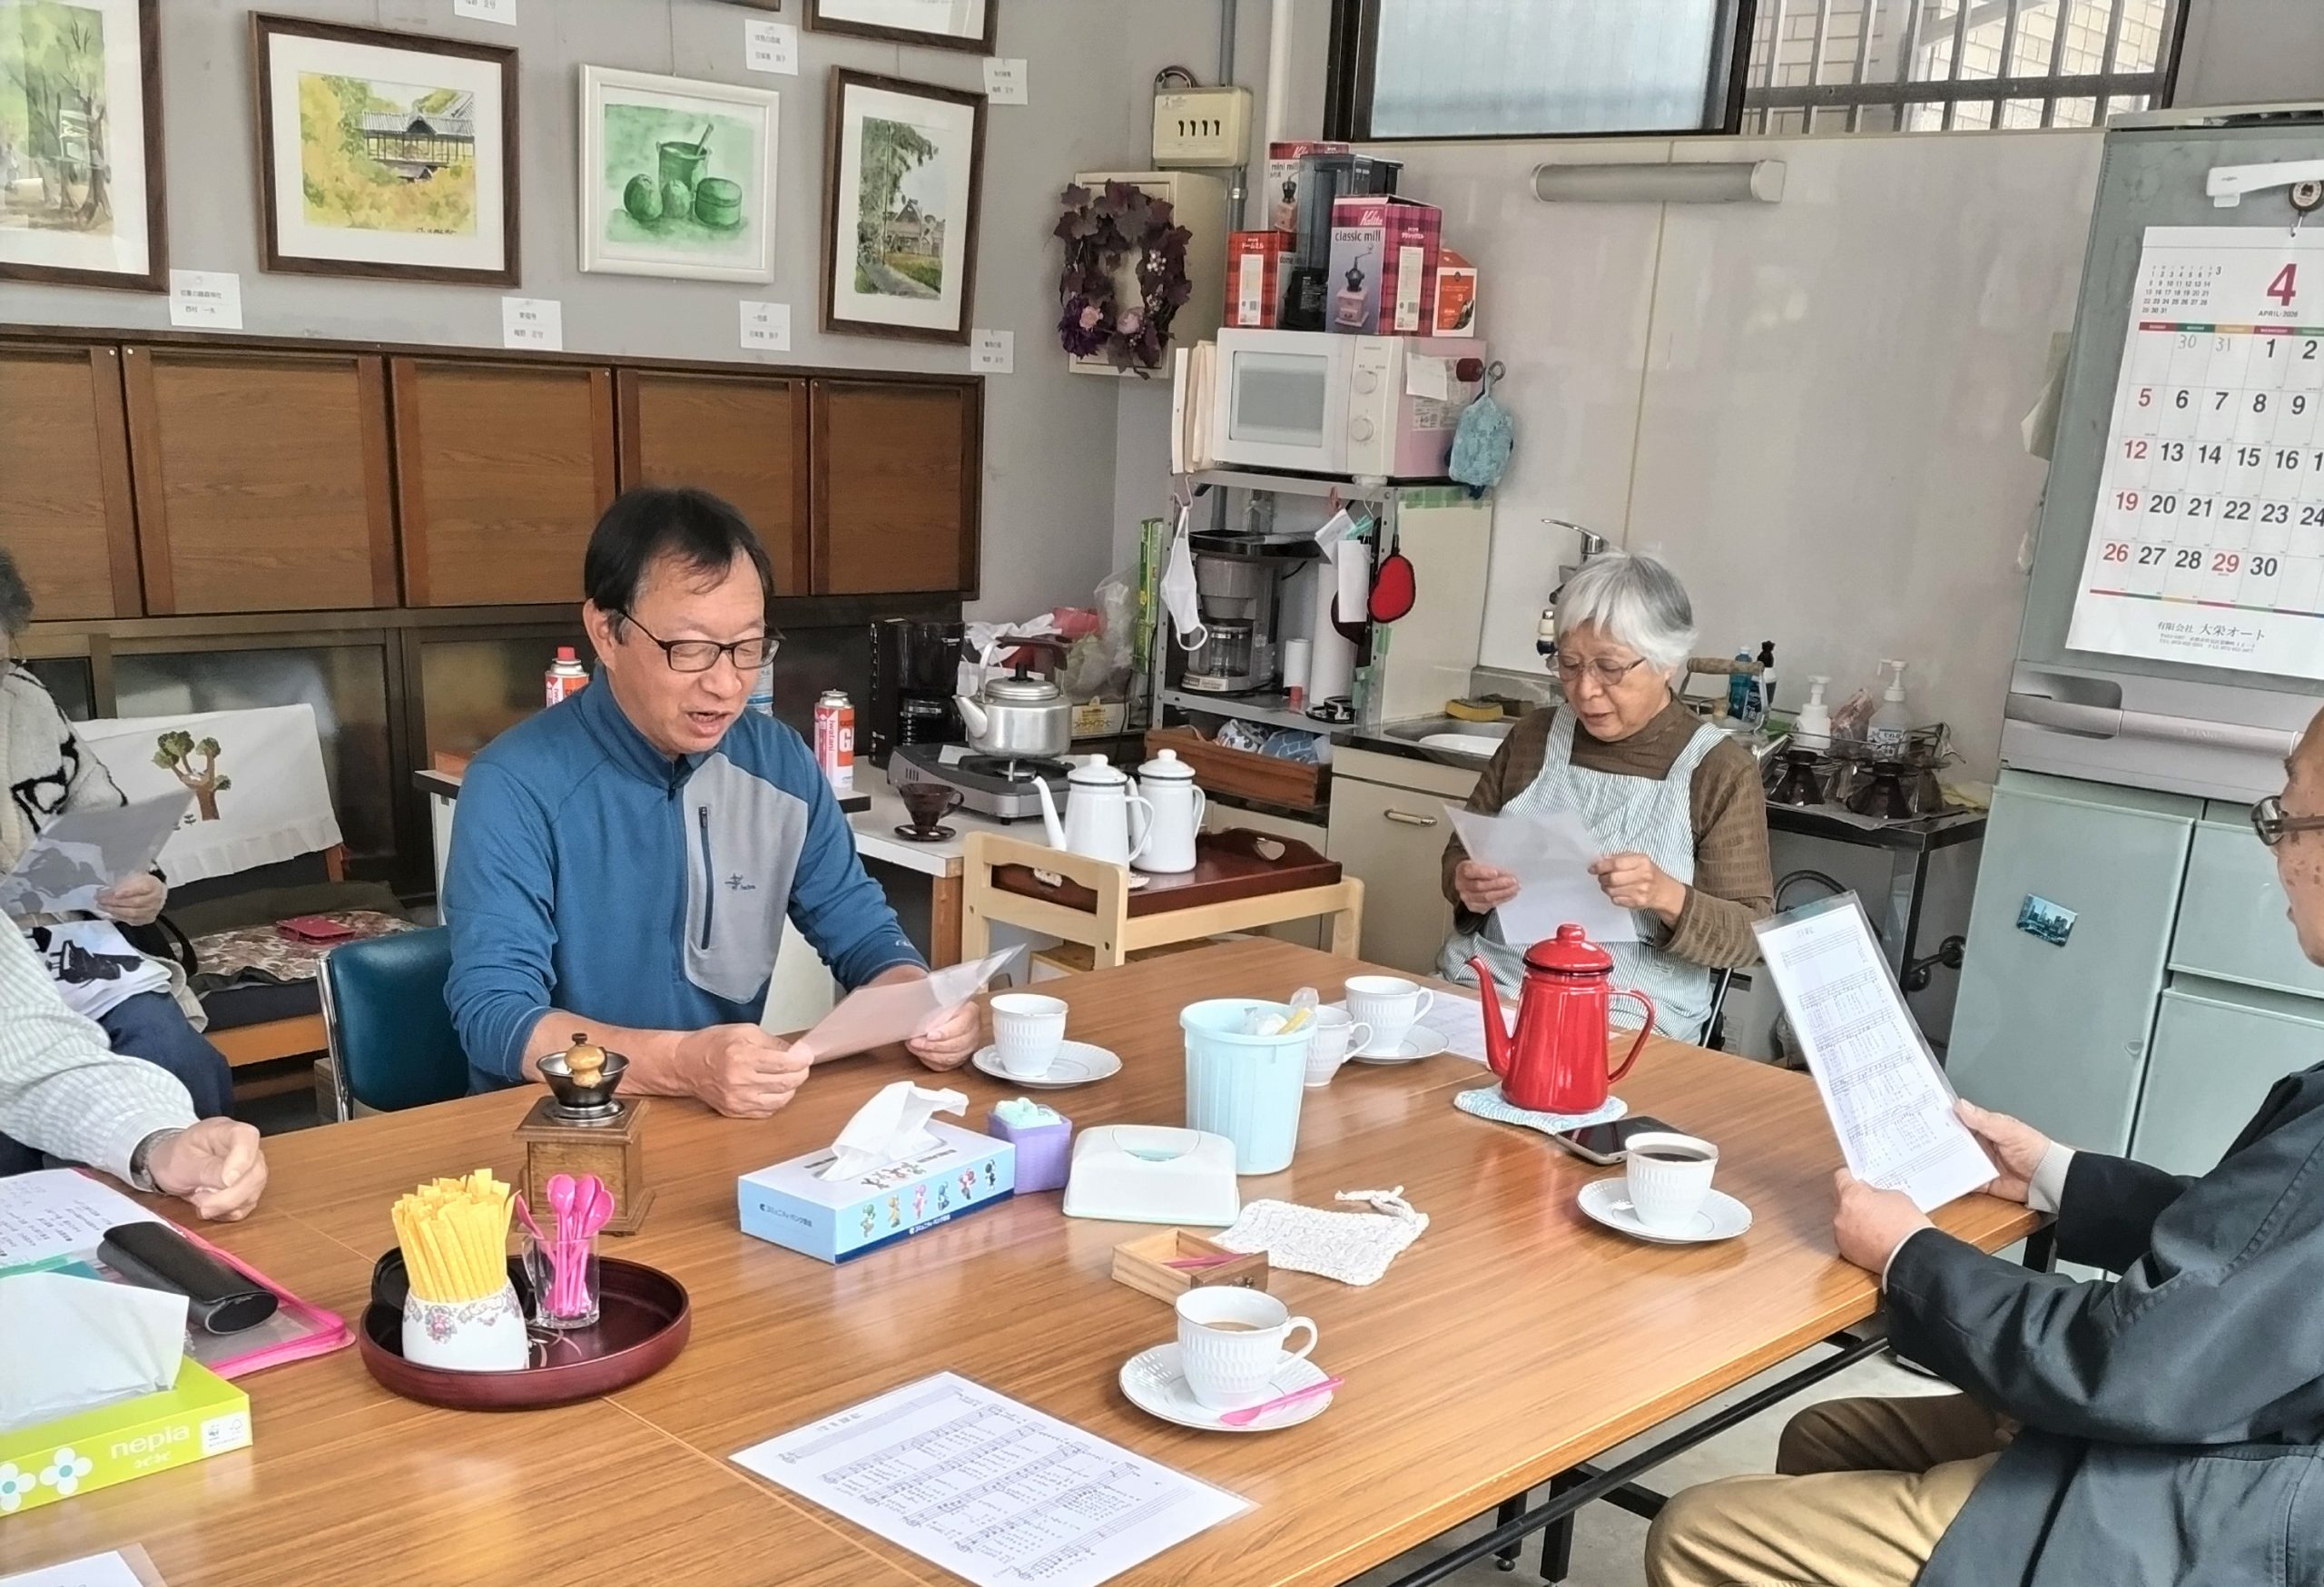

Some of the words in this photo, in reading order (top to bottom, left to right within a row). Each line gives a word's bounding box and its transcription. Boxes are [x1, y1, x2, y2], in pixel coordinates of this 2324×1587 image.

[1272, 163, 1285, 171] mini
[1360, 210, 1384, 226] Kalita
[1334, 229, 1361, 242] classic
[1364, 229, 1381, 242] mill
[2216, 266, 2221, 275] 3
[2267, 263, 2297, 306] 4
[2178, 334, 2197, 350] 30
[2216, 337, 2230, 352] 31
[2266, 339, 2276, 359] 1
[2302, 340, 2318, 360] 2
[2138, 388, 2152, 407] 5
[2176, 390, 2189, 409] 6
[2215, 392, 2229, 410] 7
[2253, 394, 2267, 412] 8
[2291, 396, 2306, 415] 9
[2124, 440, 2148, 458] 12
[2161, 443, 2184, 461] 13
[2198, 445, 2221, 464] 14
[2237, 448, 2261, 467] 15
[2276, 450, 2299, 469] 16
[2116, 491, 2139, 510] 19
[2150, 495, 2176, 514] 20
[2188, 498, 2212, 517] 21
[2223, 501, 2251, 520] 22
[2260, 504, 2289, 523] 23
[2299, 507, 2324, 527] 24
[2102, 543, 2129, 562] 26
[2139, 547, 2166, 566] 27
[2175, 550, 2202, 569] 28
[2211, 553, 2240, 573] 29
[2250, 557, 2278, 577] 30
[2158, 621, 2193, 633] 有限会社
[2200, 623, 2265, 641] 大栄オート
[111, 1424, 191, 1459] nepia
